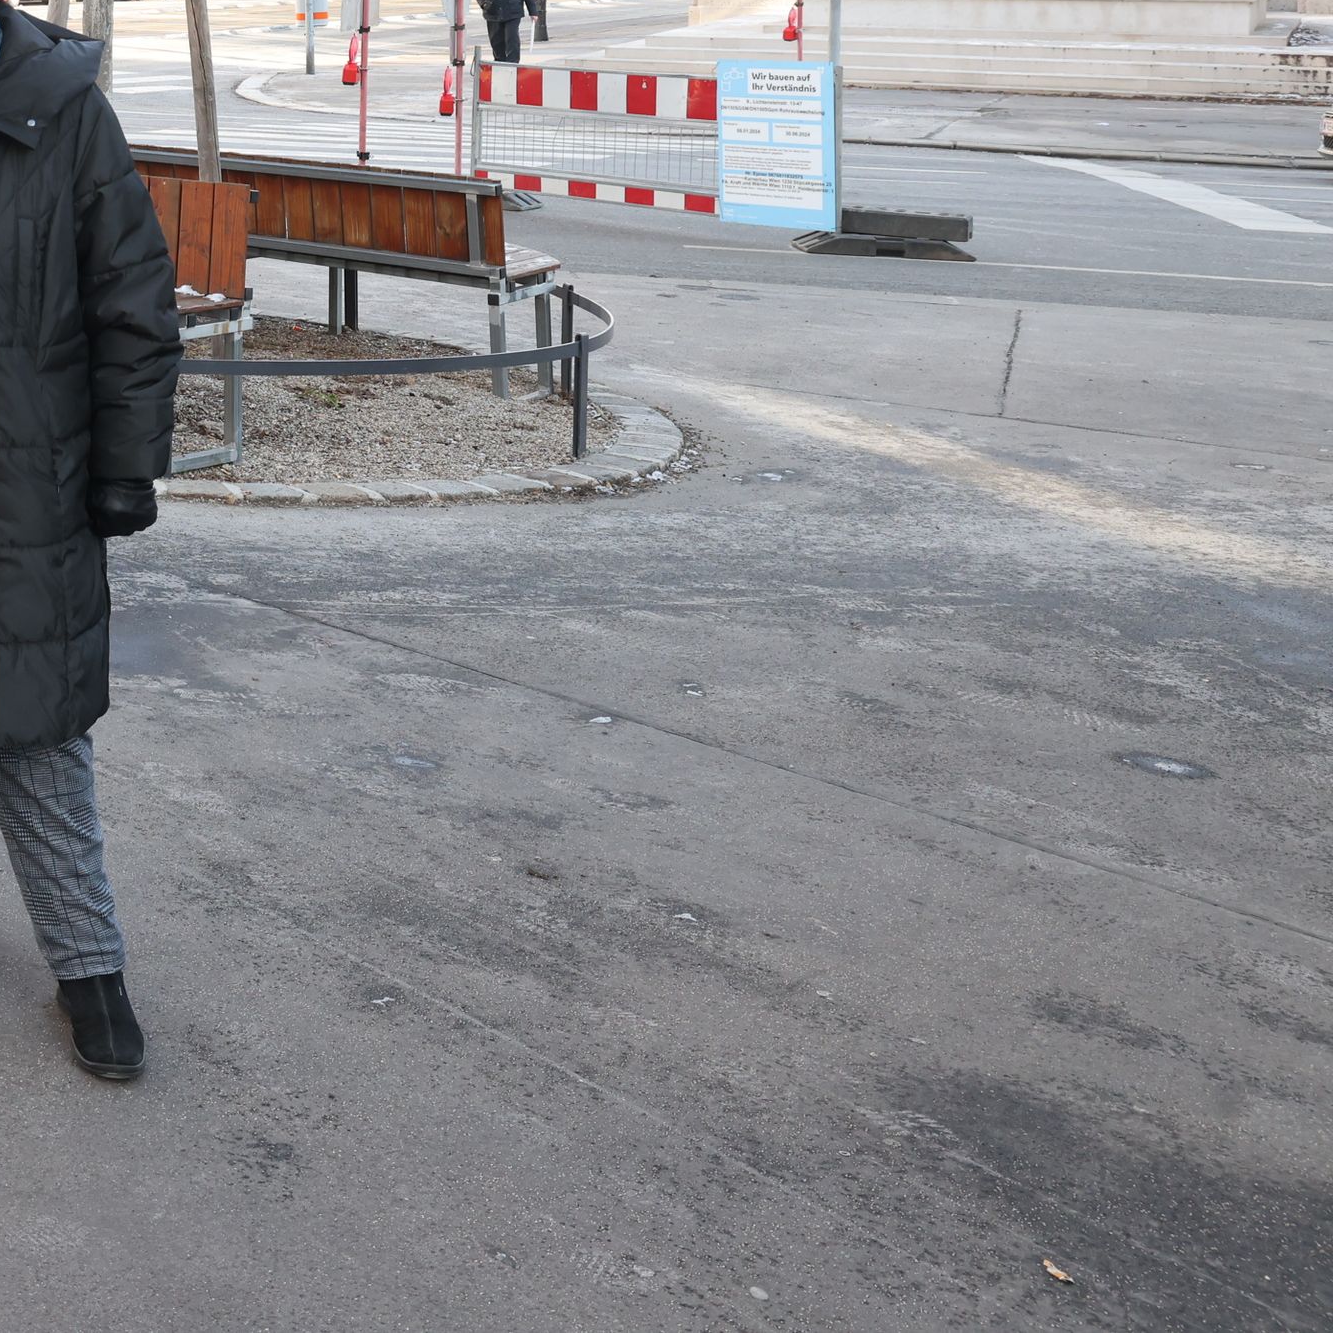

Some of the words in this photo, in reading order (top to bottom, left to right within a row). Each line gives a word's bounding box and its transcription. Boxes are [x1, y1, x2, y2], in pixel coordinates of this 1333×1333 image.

[751, 72, 767, 81] Wir
[769, 72, 795, 81] bauen
[796, 73, 811, 82] auf
[751, 82, 764, 91] Ihr
[766, 83, 817, 93] Verständnis
